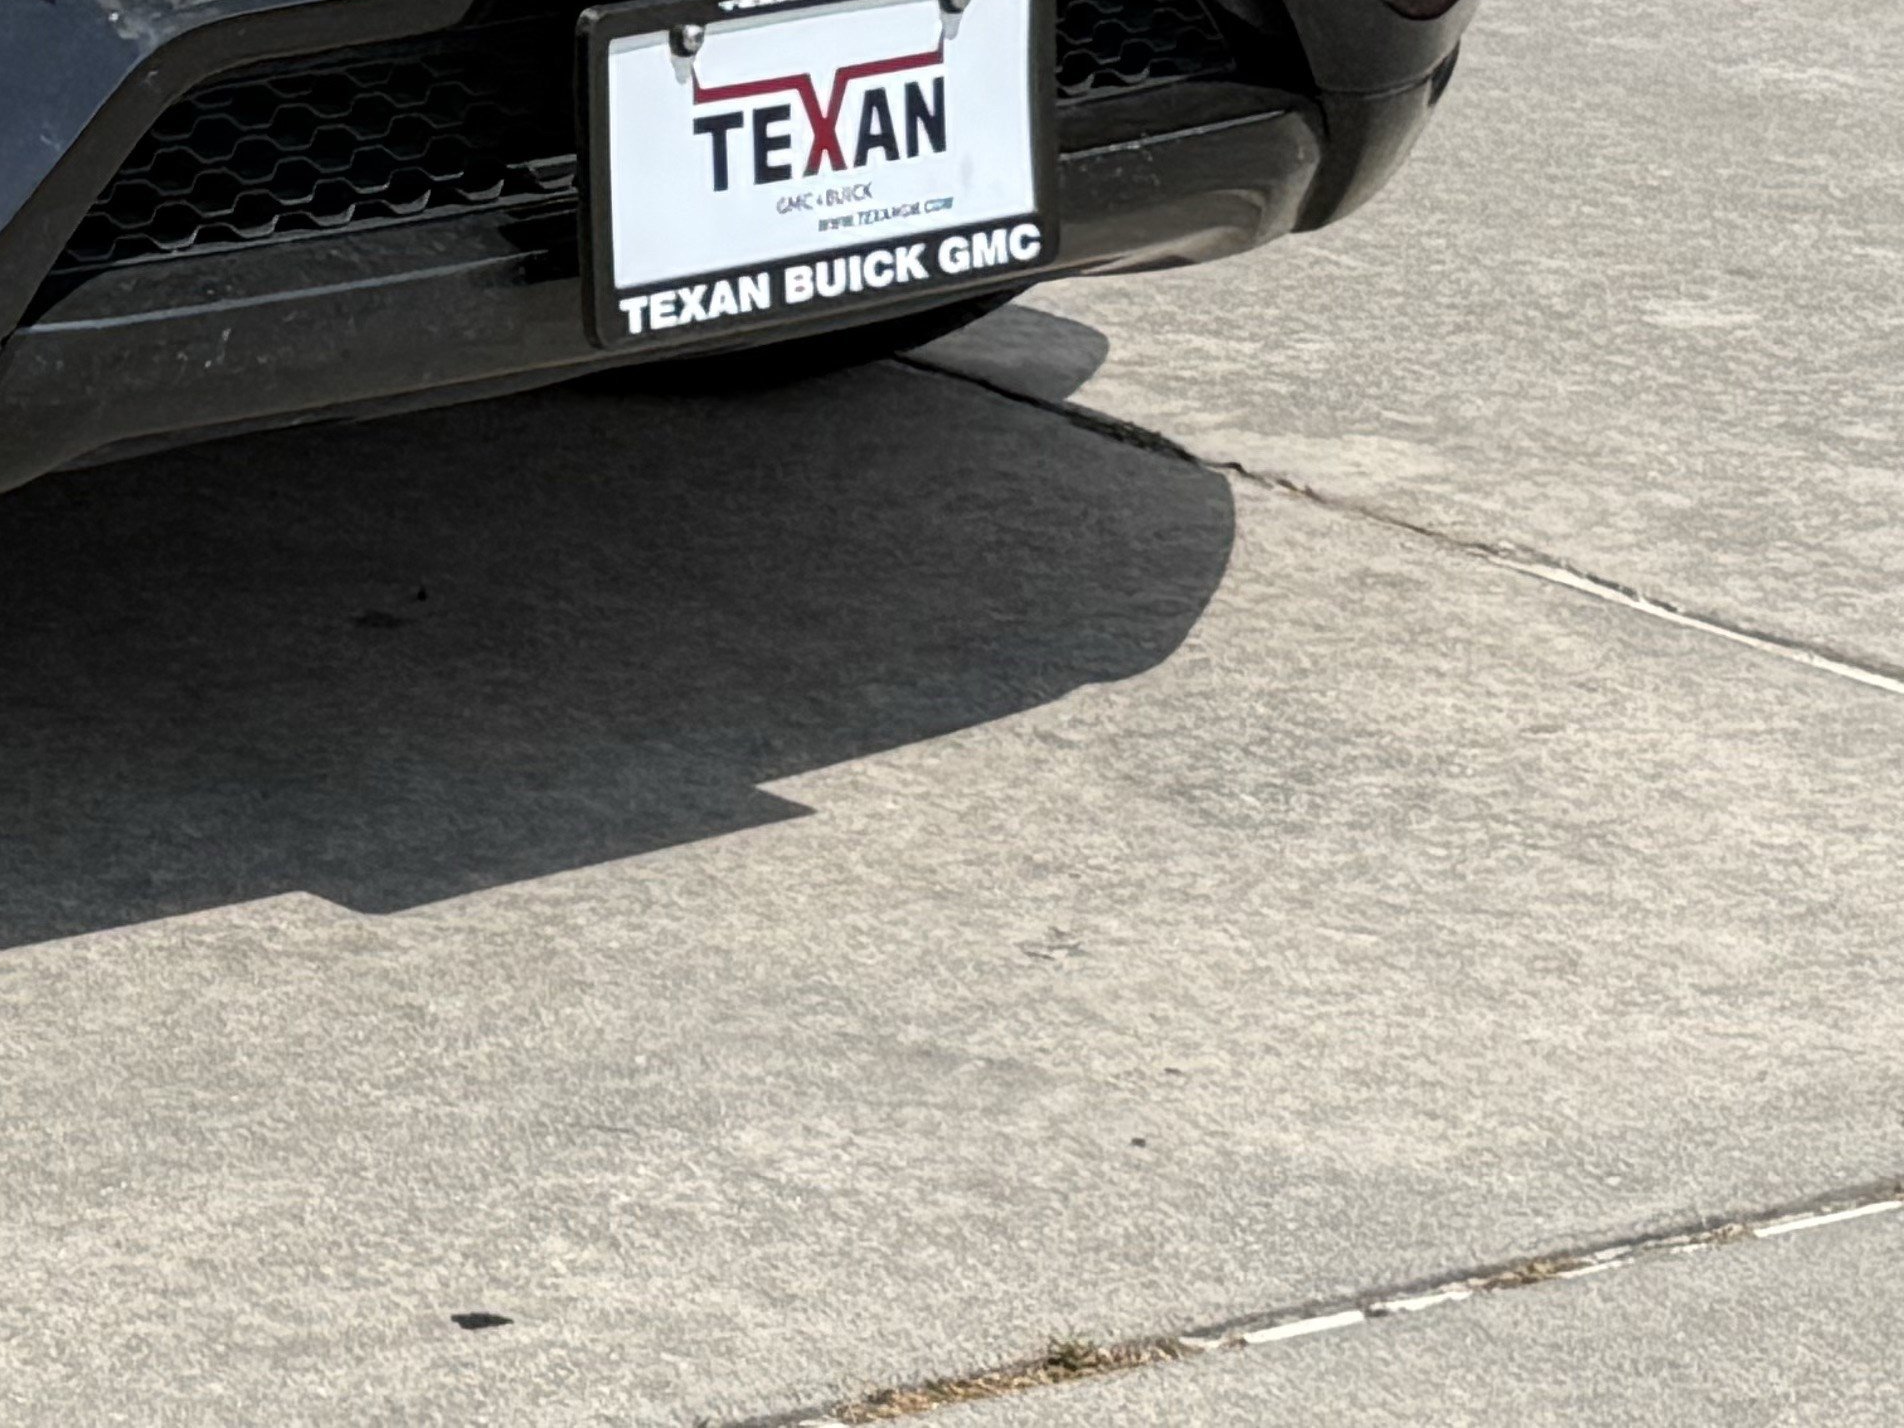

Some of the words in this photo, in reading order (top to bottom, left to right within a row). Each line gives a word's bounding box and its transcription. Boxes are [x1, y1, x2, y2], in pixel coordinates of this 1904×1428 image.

[692, 67, 947, 192] TEXAN
[619, 272, 771, 334] TEXAN
[785, 243, 929, 305] BUICK
[938, 223, 1042, 276] GMC
